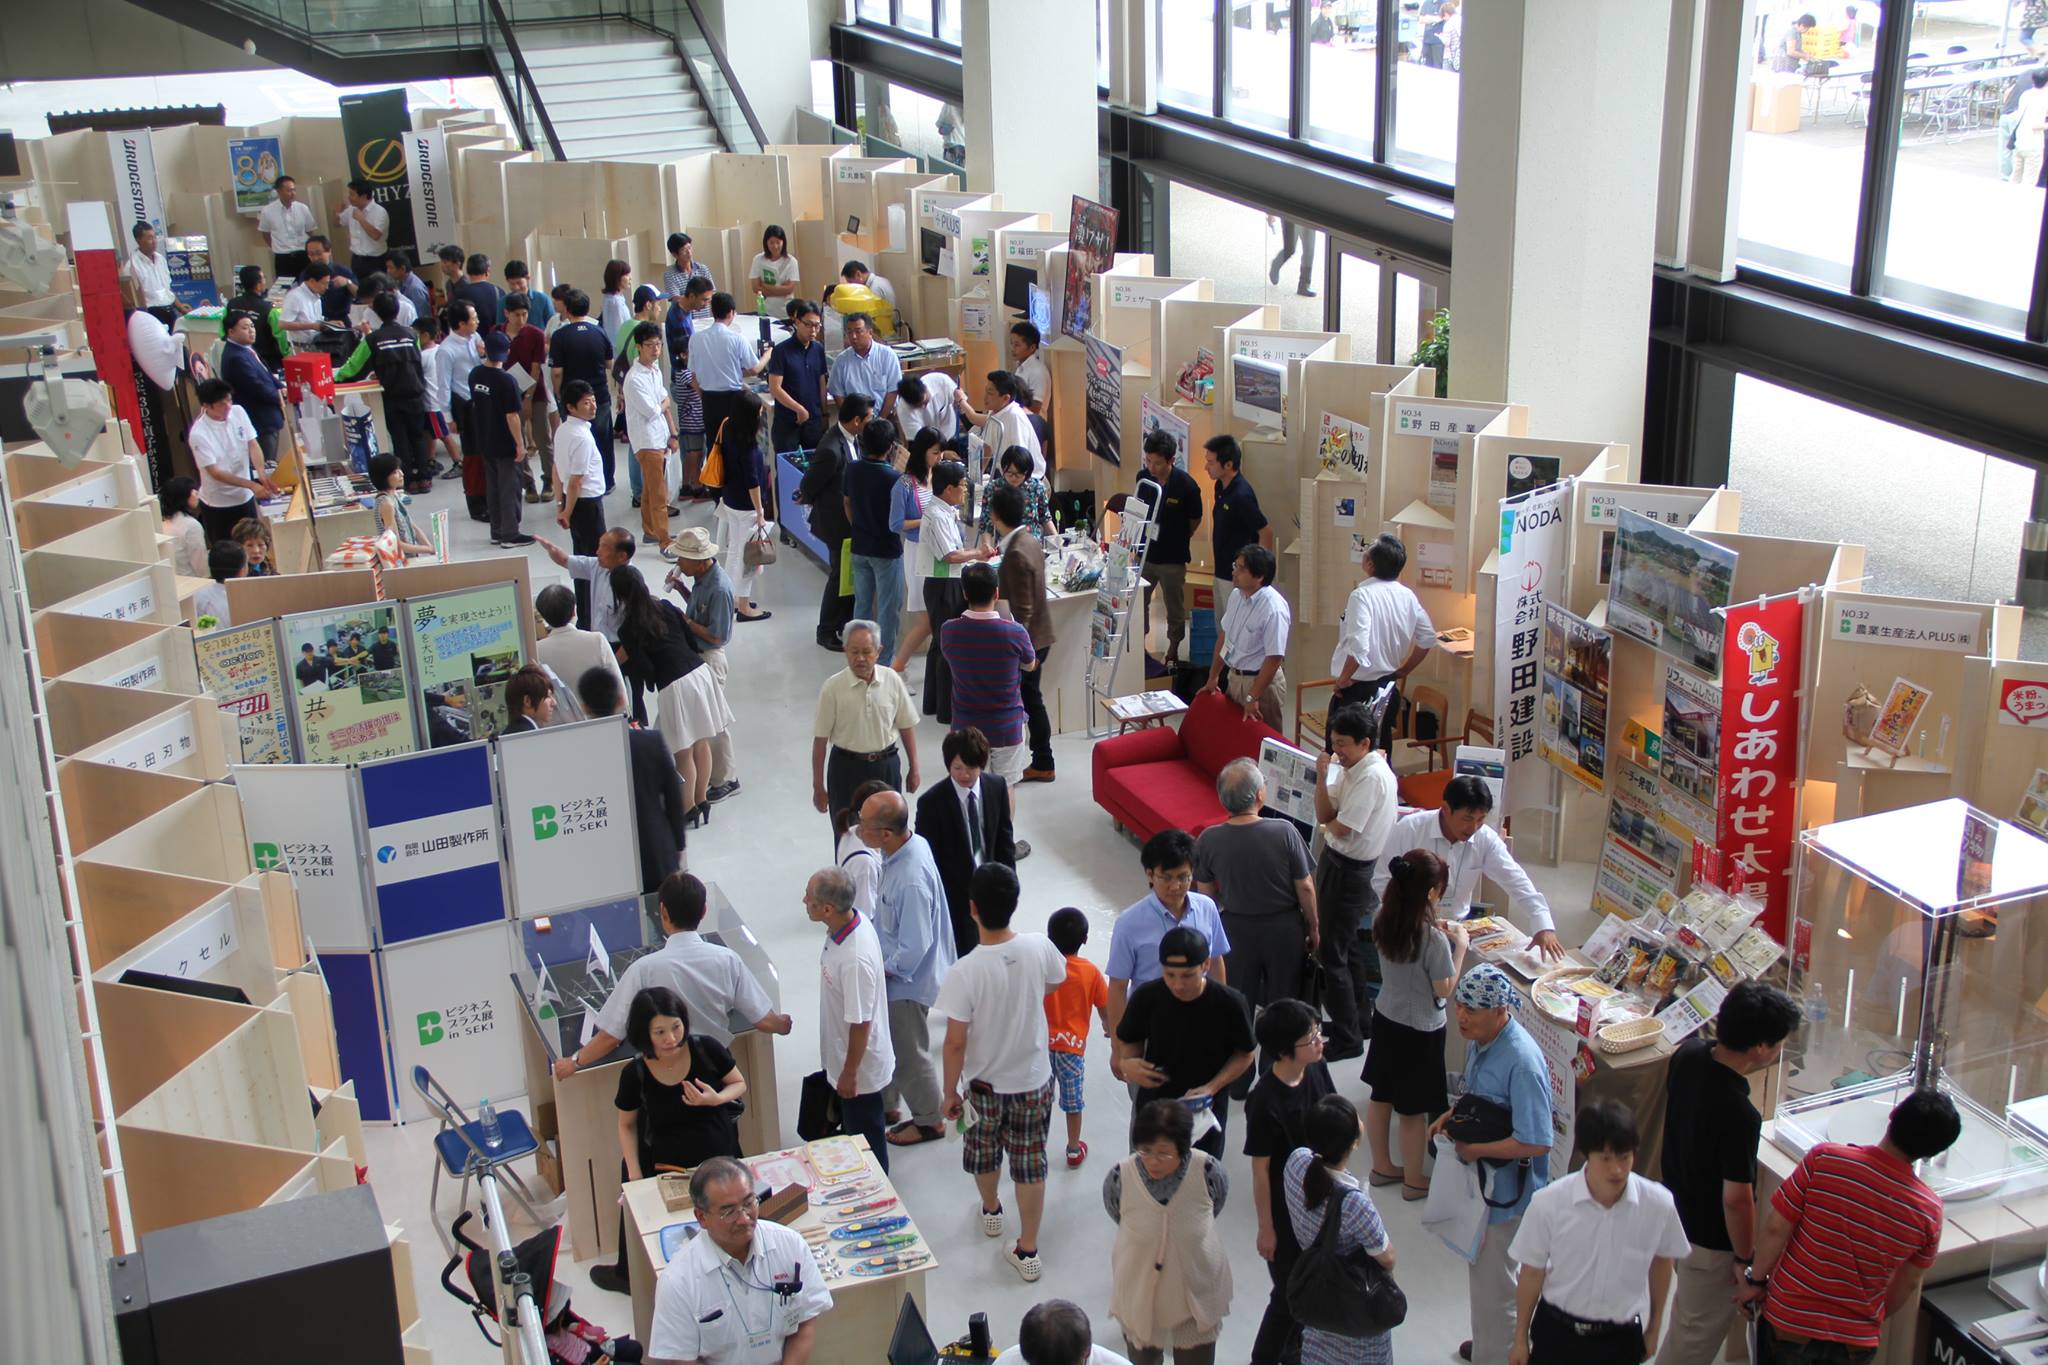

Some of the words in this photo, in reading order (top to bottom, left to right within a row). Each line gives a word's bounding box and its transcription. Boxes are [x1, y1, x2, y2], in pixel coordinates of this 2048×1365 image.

[123, 138, 147, 222] BRIDGESTON
[417, 138, 438, 229] BRIDGESTONE
[942, 215, 960, 234] PLUS
[1240, 340, 1258, 348] NO.35
[1401, 409, 1421, 417] NO.34
[1412, 419, 1476, 433] 野田産業
[1592, 496, 1615, 504] NO.33
[1515, 507, 1562, 533] NODA
[1841, 609, 1870, 620] NO.32
[1547, 607, 1597, 644] 家を建てたい
[1856, 623, 1955, 643] 農業生産法人PLUS
[1666, 666, 1720, 705] リフォームしたい
[1510, 627, 1539, 762] 野田建設
[561, 796, 606, 812] ビジネス
[1730, 692, 1780, 928] しあわせ太
[562, 807, 607, 824] プラス展
[563, 827, 574, 835] in
[580, 820, 607, 832] SEKI
[283, 843, 332, 854] ビジネス
[422, 828, 489, 853] 山田製作所
[304, 868, 334, 877] SEKI
[446, 1000, 492, 1017] ビジネス
[448, 1010, 493, 1029] プラス展
[449, 1031, 459, 1039] in
[465, 1022, 493, 1035] SEKI
